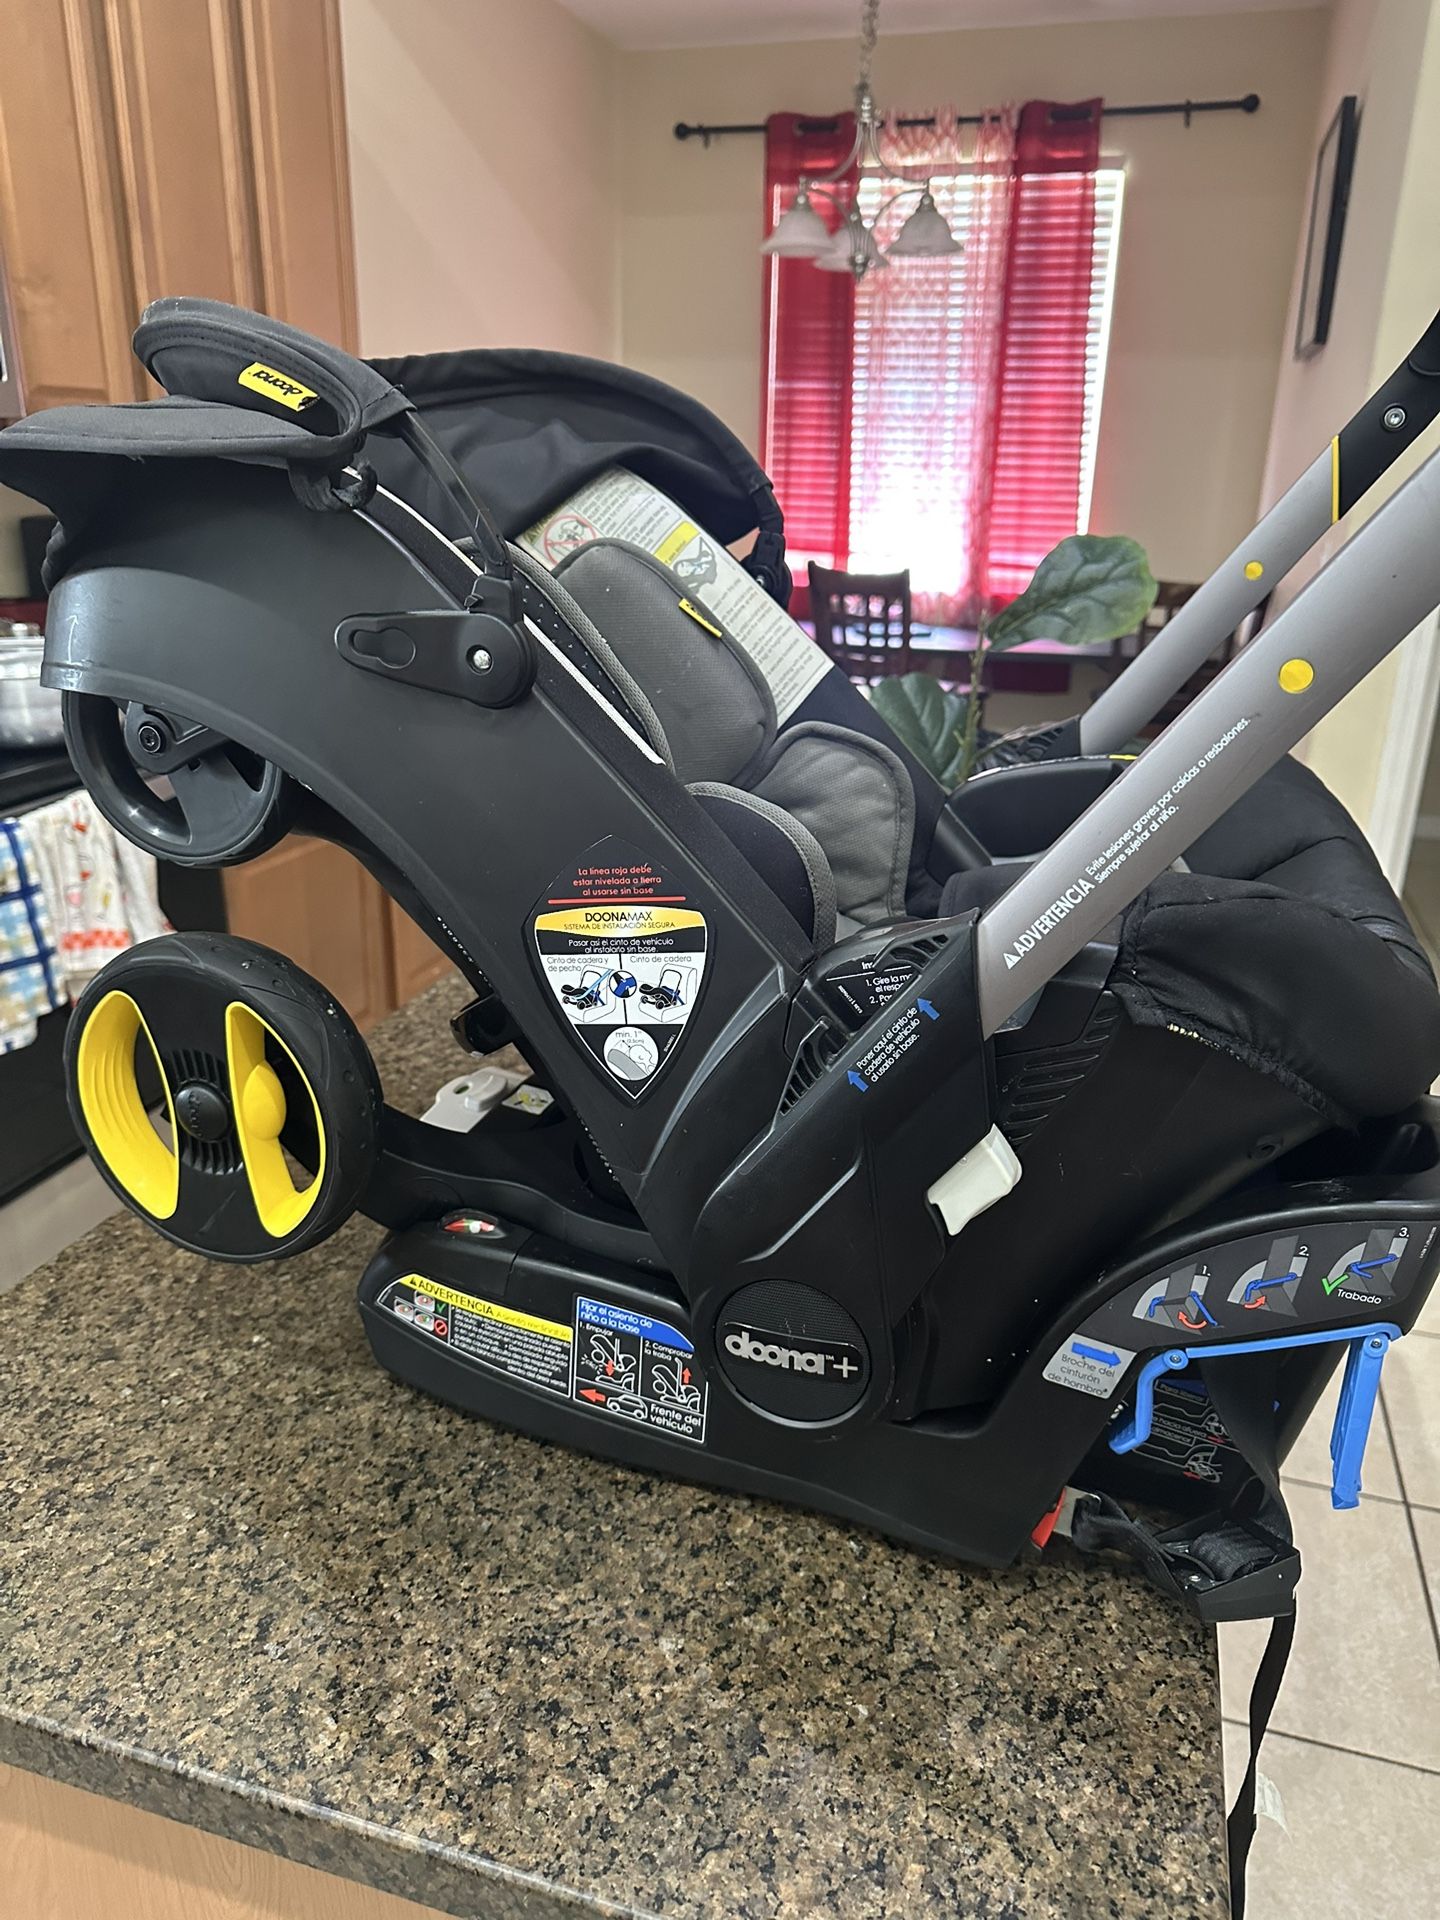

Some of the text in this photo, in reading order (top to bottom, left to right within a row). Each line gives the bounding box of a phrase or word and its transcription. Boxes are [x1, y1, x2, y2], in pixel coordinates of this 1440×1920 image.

[1013, 878, 1095, 957] ADVERTENCIA
[1085, 857, 1106, 876] Evite
[1102, 829, 1134, 859] lesiones
[1133, 804, 1160, 833] graves
[1157, 790, 1173, 809] por
[1198, 759, 1207, 768] o
[1204, 718, 1251, 762] resbalones.
[1094, 853, 1126, 883] Siempre
[1124, 829, 1151, 857] sujetar
[1149, 820, 1160, 832] al
[612, 867, 628, 876] roja
[595, 877, 631, 886] nivelada
[640, 876, 662, 884] tierra
[583, 888, 591, 896] al
[585, 911, 653, 922] DOONAMAX
[568, 939, 589, 947] Pasar
[626, 945, 637, 953] sin
[638, 945, 659, 953] base.
[546, 956, 567, 964] Cinto
[630, 955, 692, 963] Cinto de cadera
[557, 964, 581, 972] pecho
[872, 976, 890, 986] Gire
[891, 974, 899, 982] la
[869, 995, 878, 1004] 2.
[856, 1050, 875, 1070] Poner
[886, 1029, 894, 1040] el
[892, 1016, 908, 1033] cinto
[906, 1007, 918, 1018] de
[864, 1052, 887, 1076] cadera
[885, 1043, 895, 1054] de
[871, 1072, 879, 1082] al
[892, 1049, 904, 1060] sin
[899, 1034, 920, 1051] base.
[1399, 1226, 1410, 1238] 3.
[1298, 1245, 1309, 1256] 2.
[1202, 1265, 1211, 1276] 1.
[419, 1279, 493, 1315] ADVERTENCIA
[1337, 1288, 1381, 1305] Trabado
[581, 1301, 653, 1329] Fijar el asiento de
[580, 1311, 641, 1335] niño a la base
[586, 1323, 613, 1337] Empujar
[645, 1340, 694, 1359] 2. Comprobar
[652, 1349, 672, 1361] traba
[1061, 1353, 1115, 1378] Broche del
[1048, 1372, 1061, 1380] de
[1060, 1366, 1100, 1384] cinturón
[650, 1403, 701, 1426] Frente del
